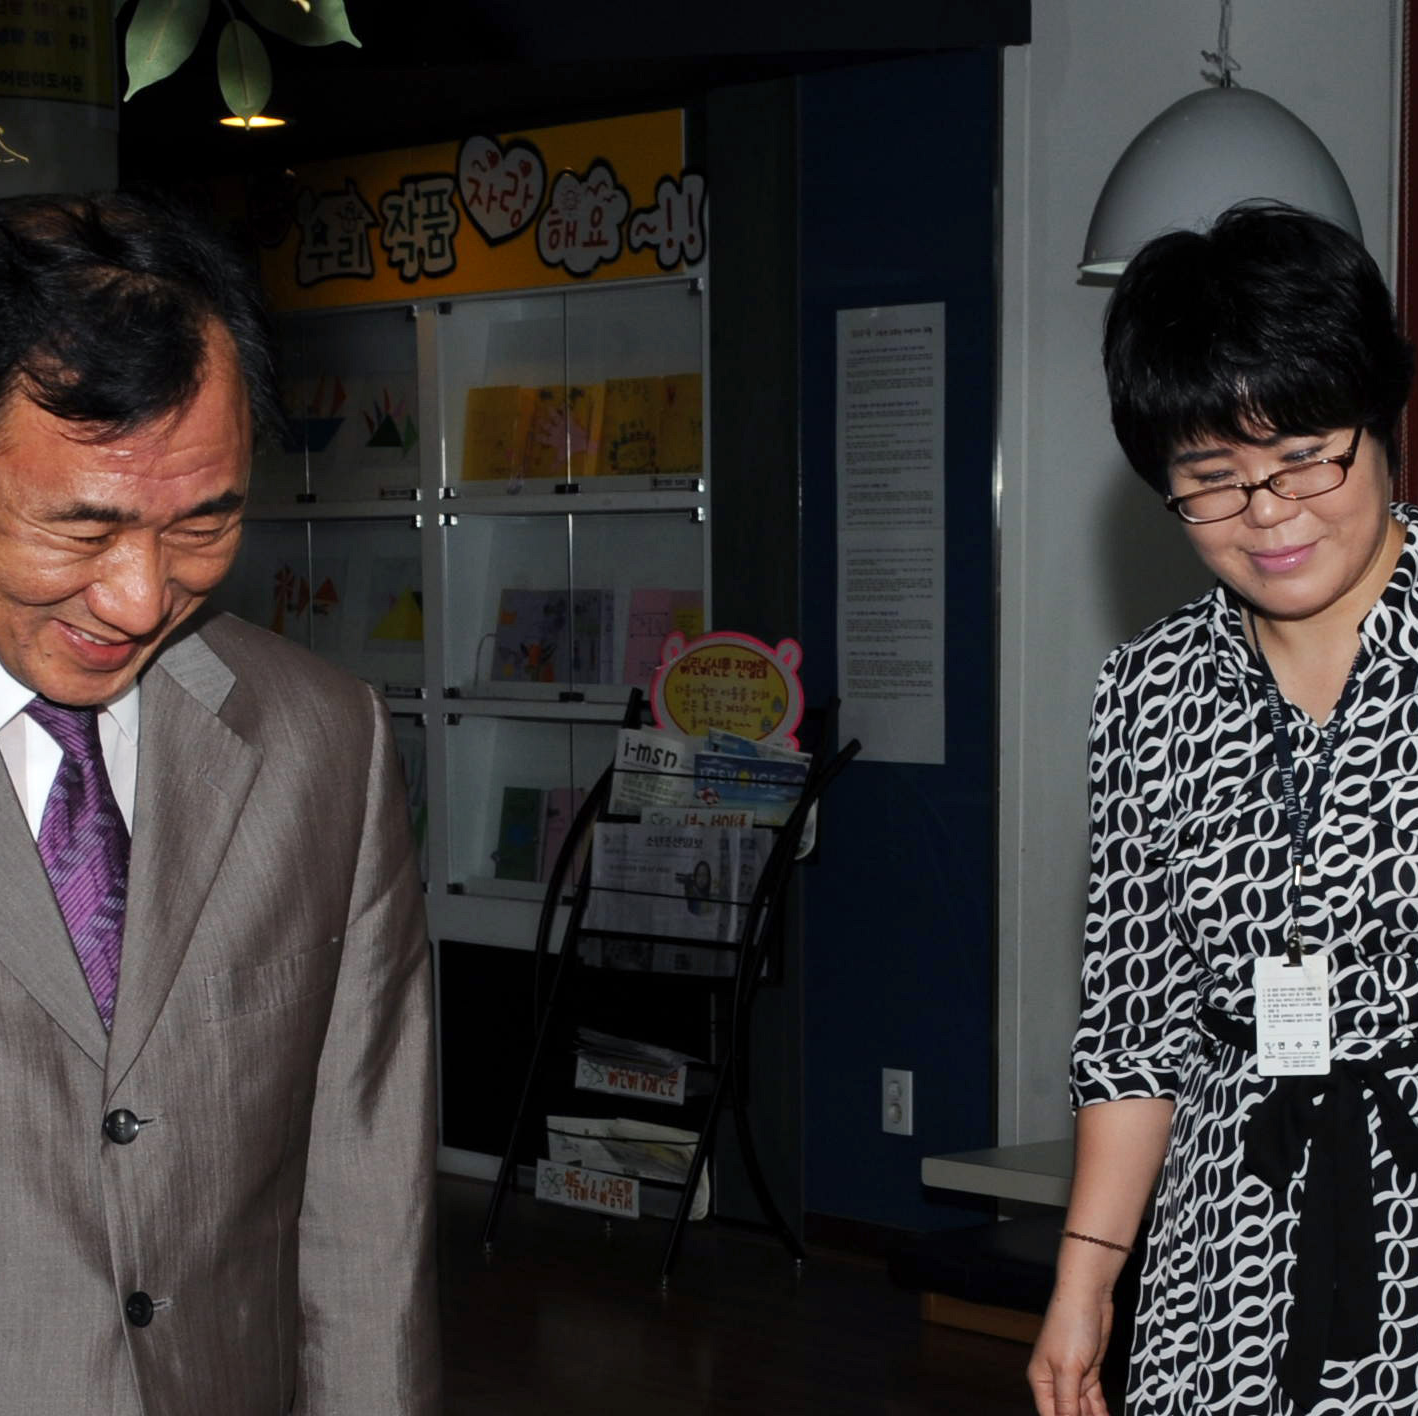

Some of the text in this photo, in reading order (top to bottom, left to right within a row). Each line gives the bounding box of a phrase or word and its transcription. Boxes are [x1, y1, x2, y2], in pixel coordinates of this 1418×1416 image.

[306, 222, 366, 268] 우리
[388, 189, 451, 264] 작품
[467, 171, 534, 229] 자랑
[546, 207, 610, 251] 해요
[623, 736, 678, 769] i-msn
